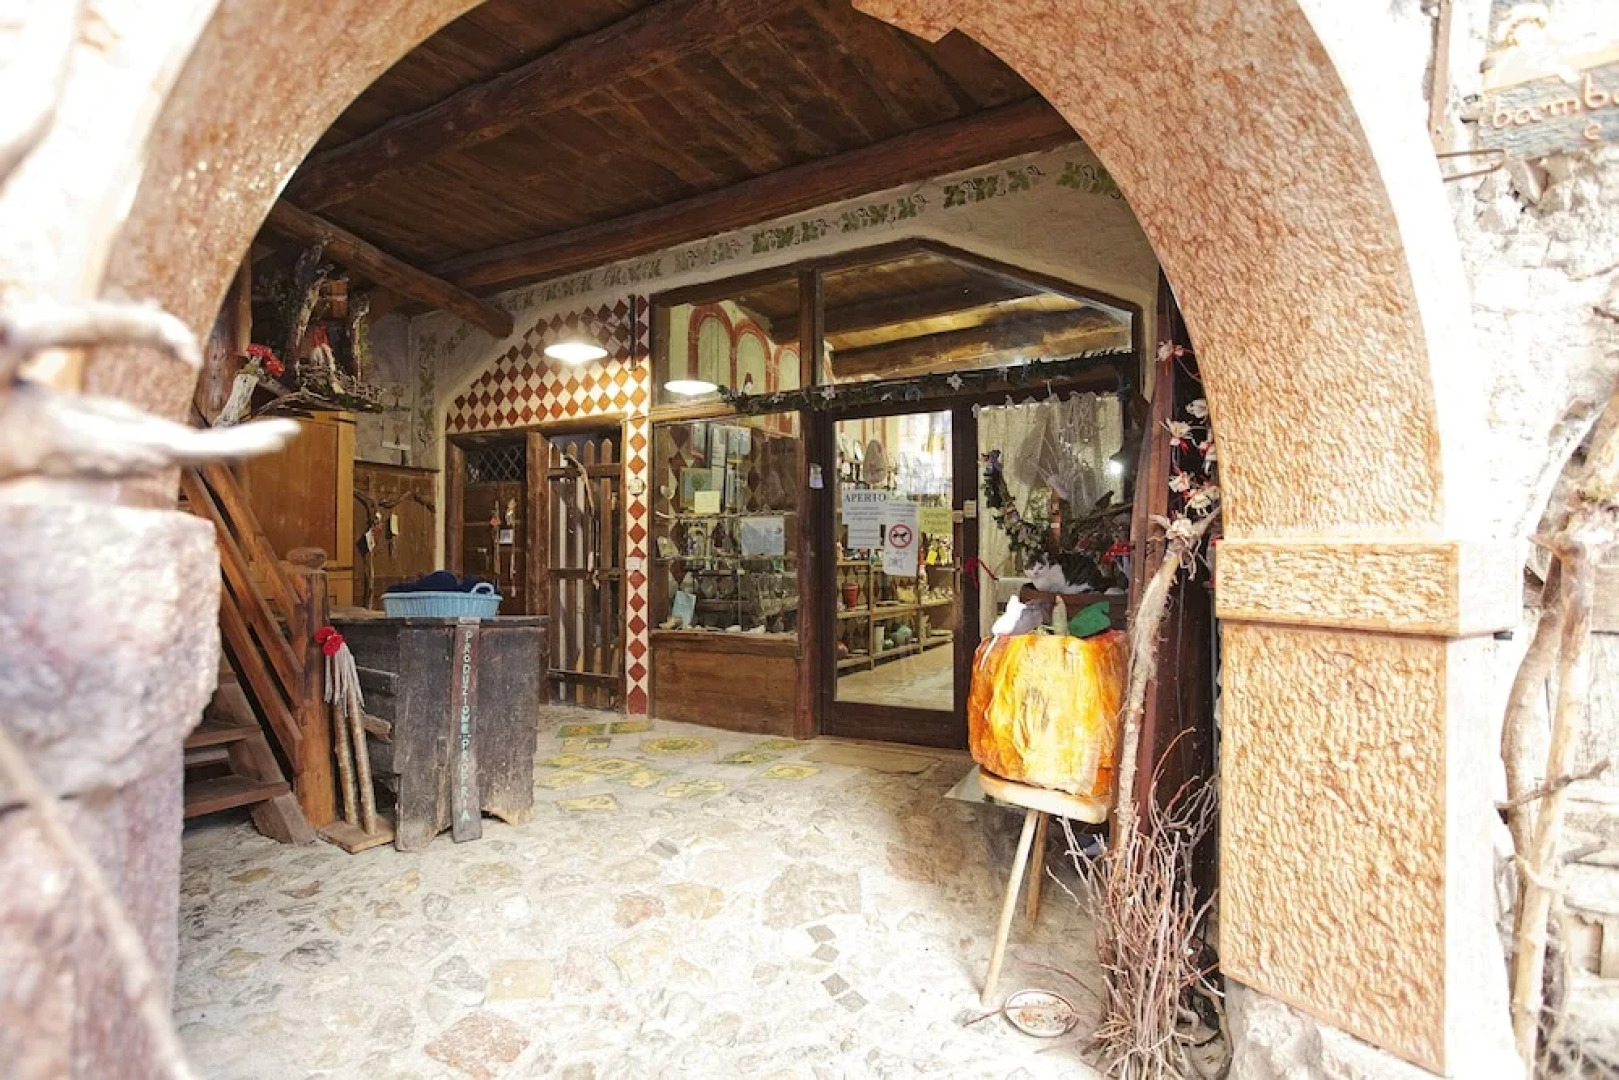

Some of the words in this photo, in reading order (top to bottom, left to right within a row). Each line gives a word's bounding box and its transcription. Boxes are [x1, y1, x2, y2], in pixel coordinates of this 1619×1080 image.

[844, 493, 886, 503] APERTO
[461, 630, 473, 734] PRODUZIONE
[460, 738, 472, 822] PROPRIA
